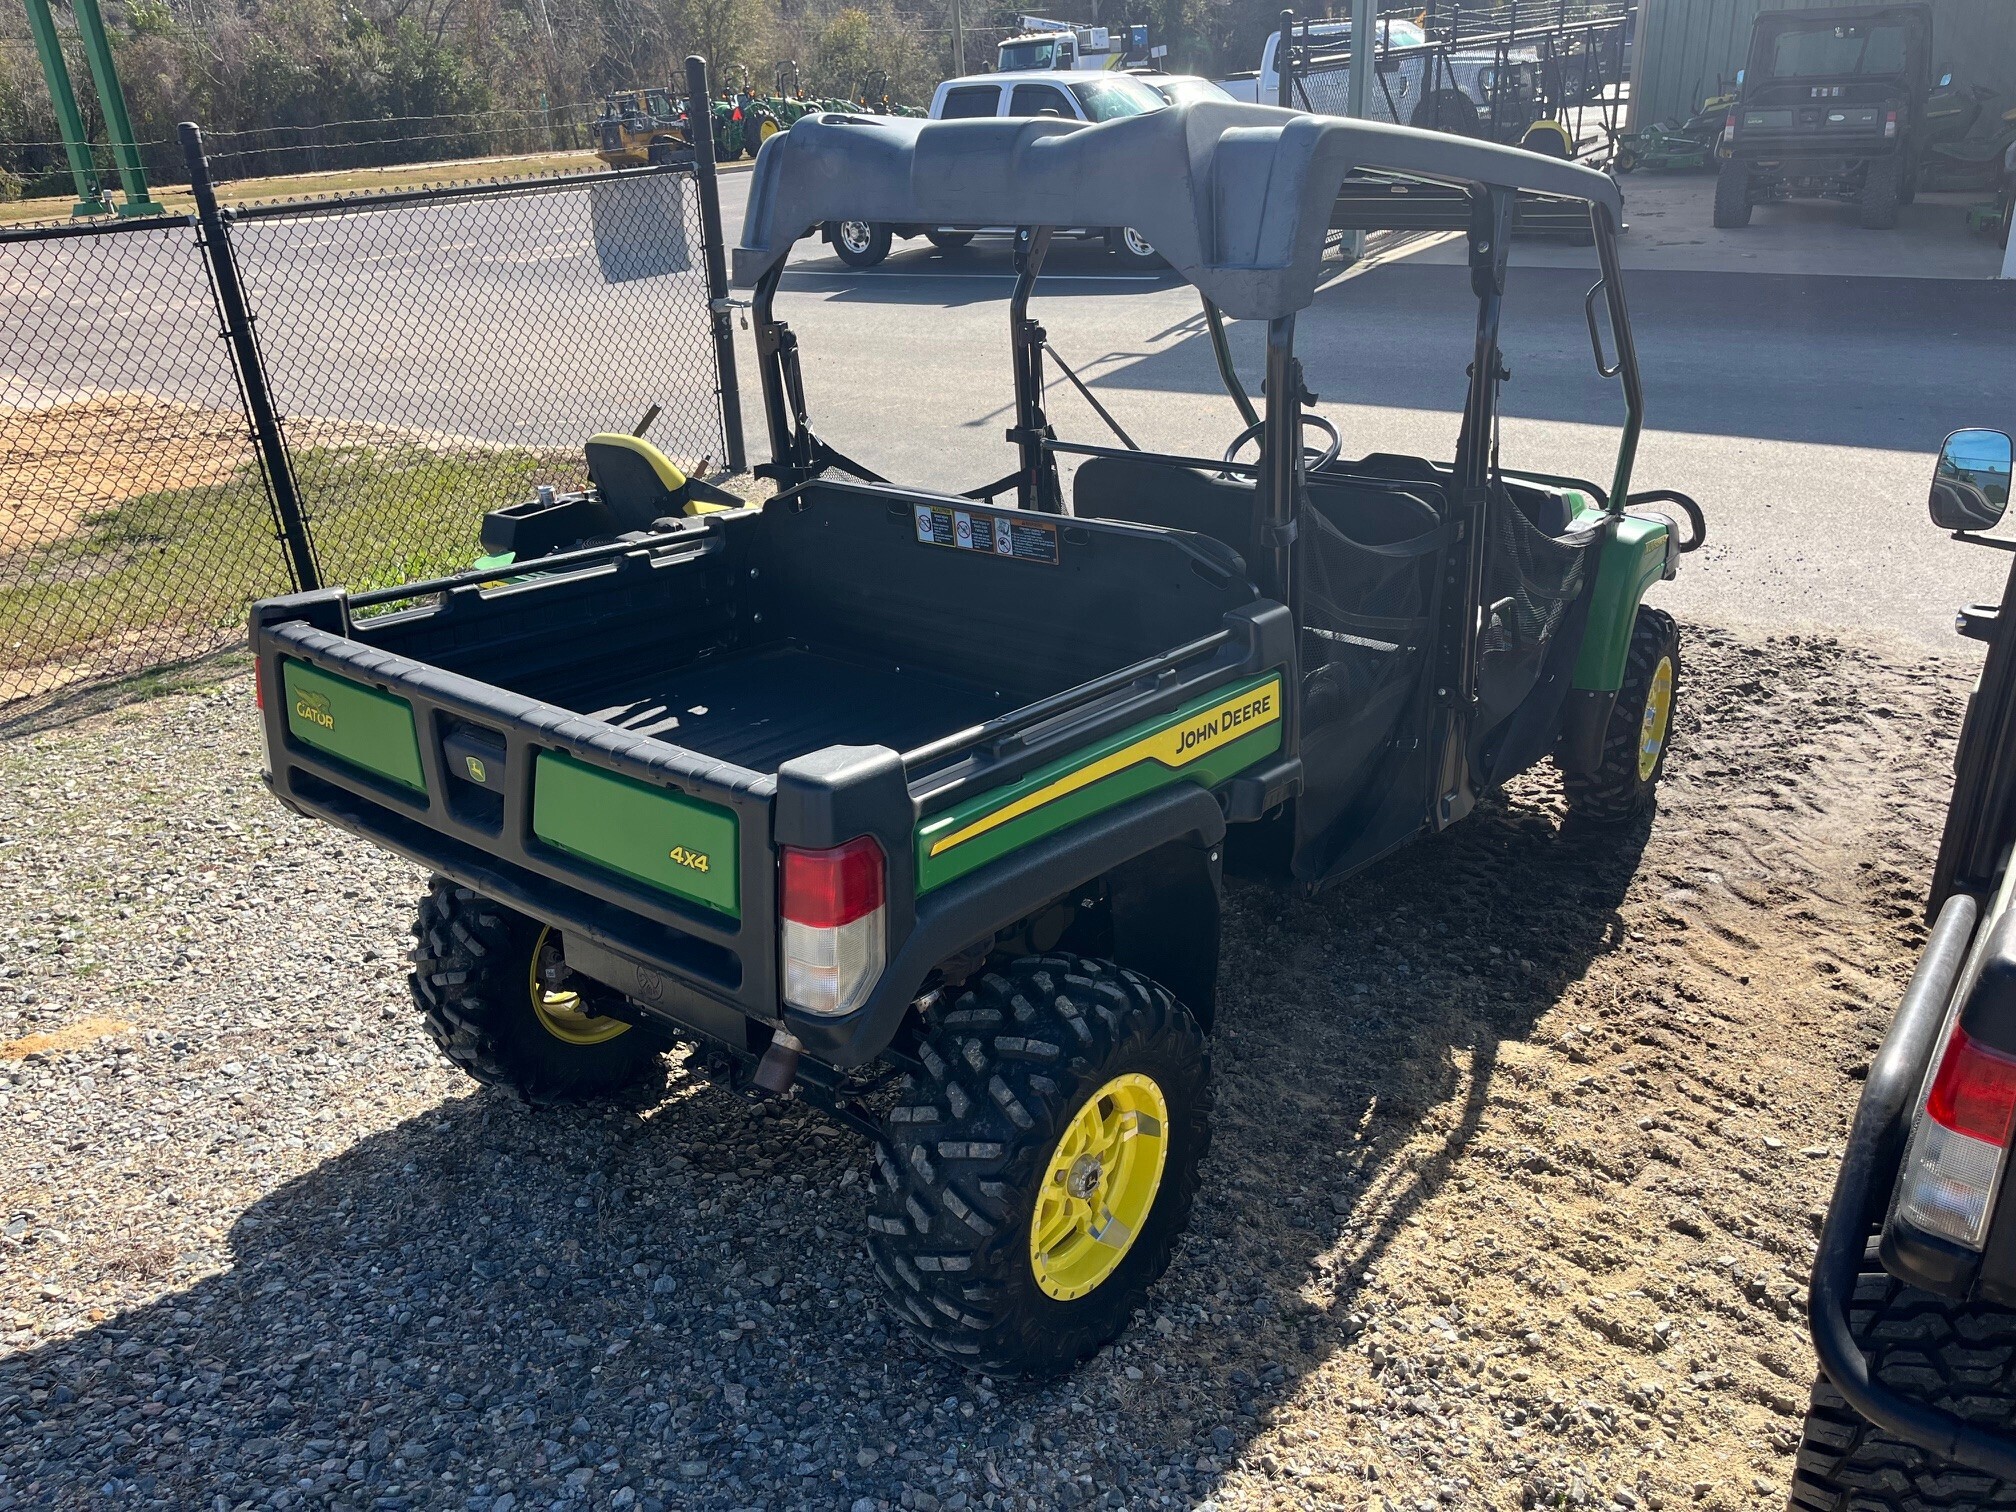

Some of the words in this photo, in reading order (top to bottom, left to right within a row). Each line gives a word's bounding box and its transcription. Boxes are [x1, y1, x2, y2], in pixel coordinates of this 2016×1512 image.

[296, 701, 334, 730] GATOR
[1176, 719, 1218, 755] JOHN
[1222, 695, 1271, 732] DEERE
